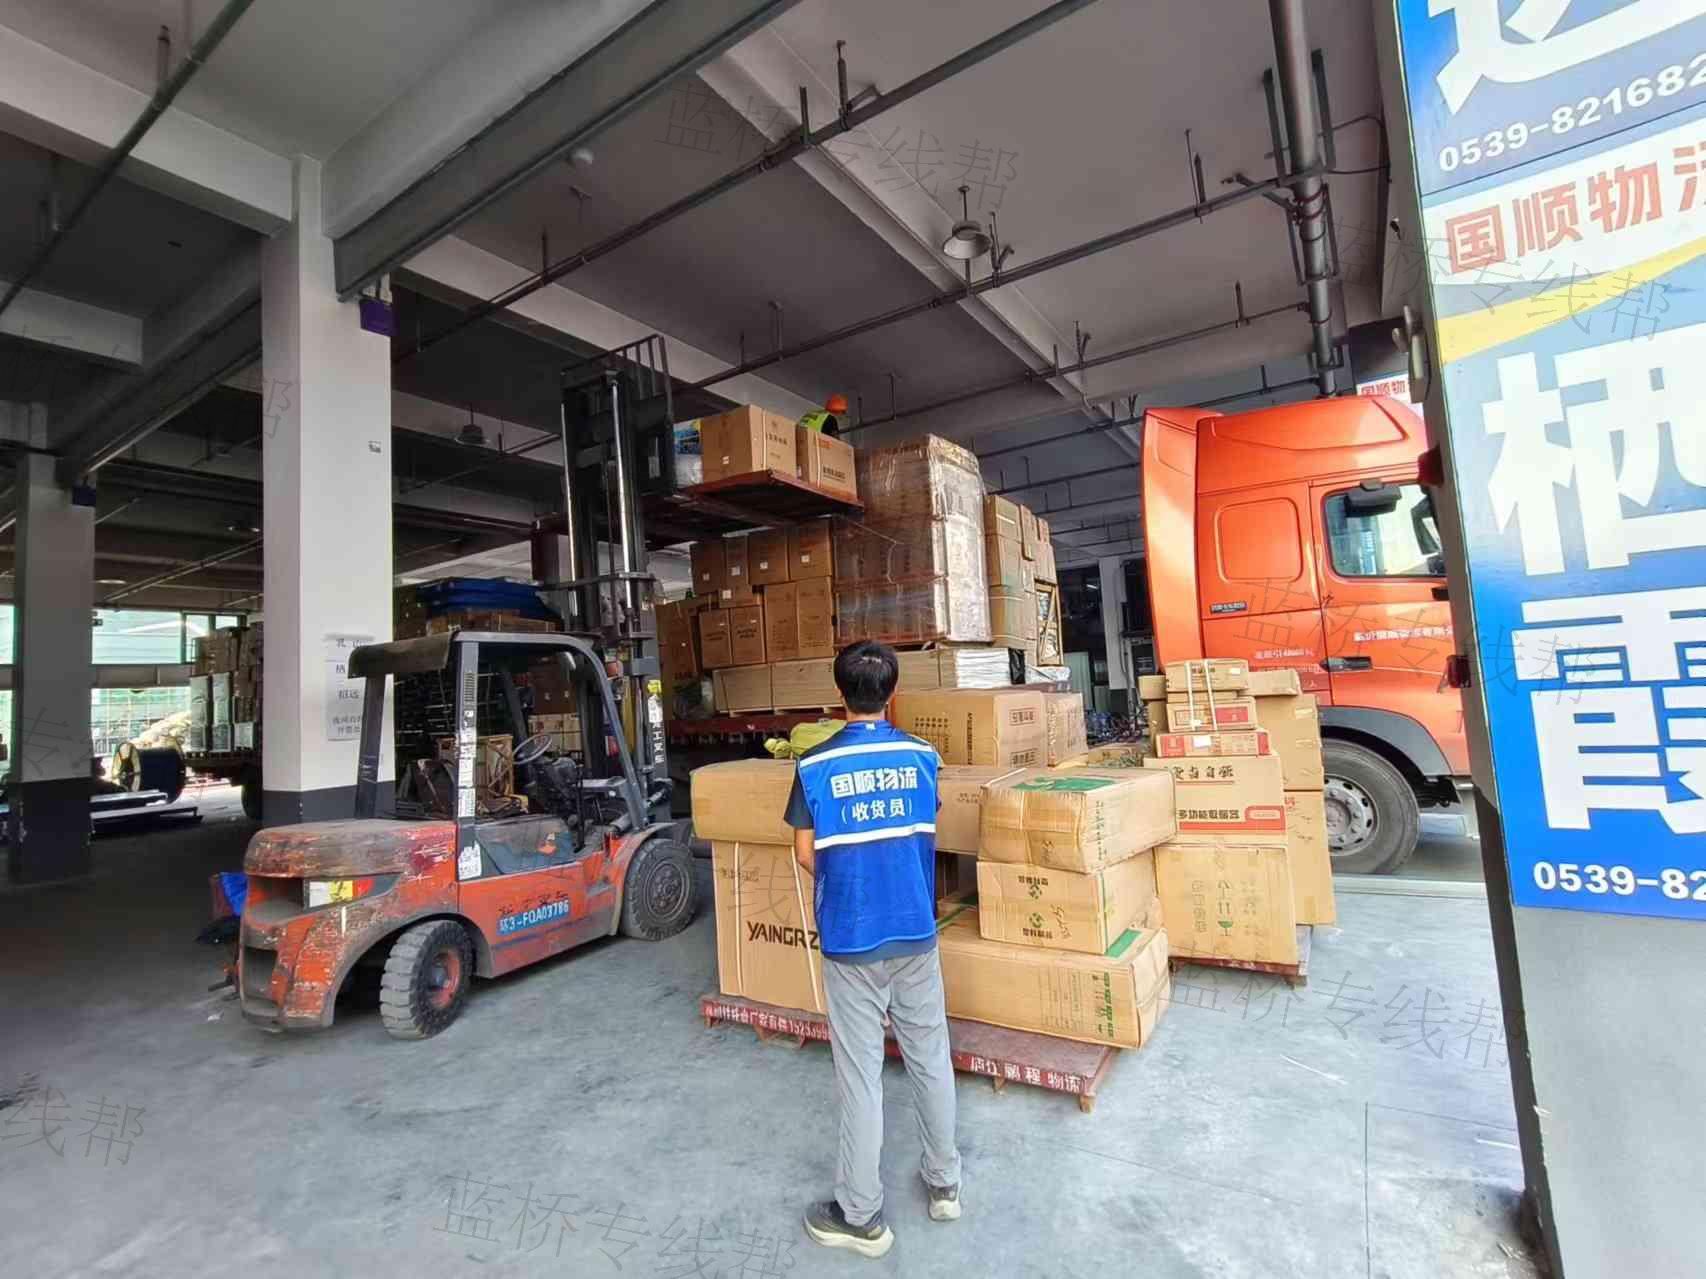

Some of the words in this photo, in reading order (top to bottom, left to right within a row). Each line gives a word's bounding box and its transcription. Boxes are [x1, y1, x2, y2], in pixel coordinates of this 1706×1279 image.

[830, 766, 918, 798] 国顺物流
[1533, 861, 1706, 901] 0539-82
